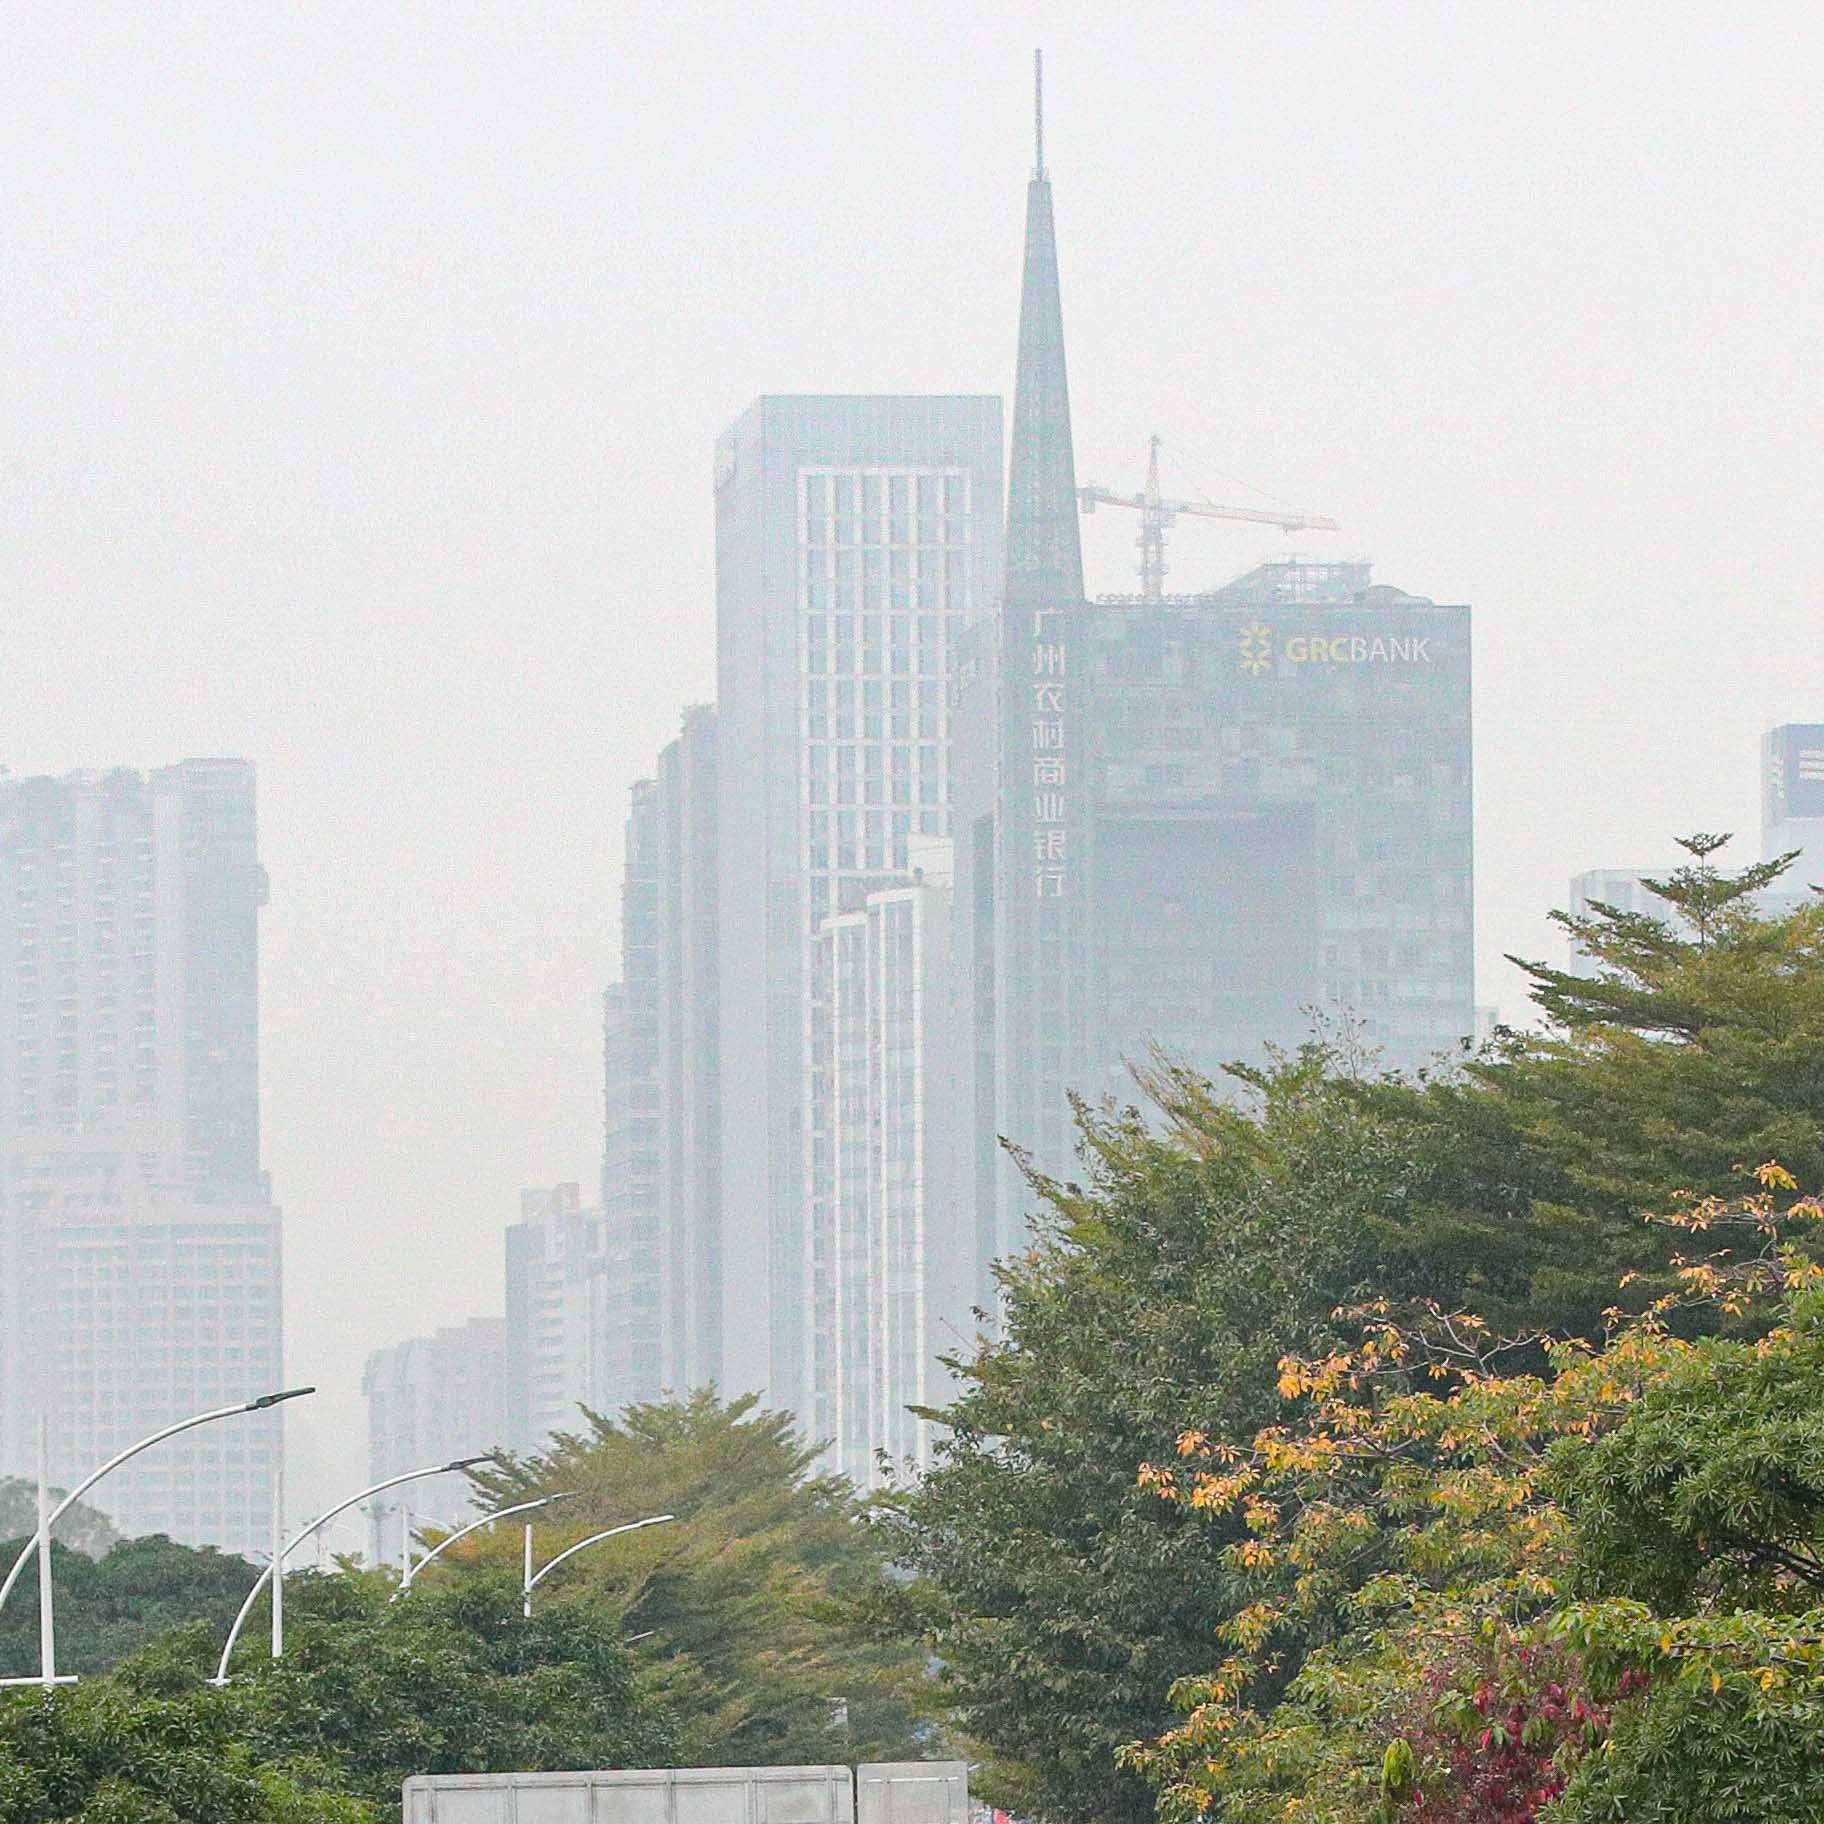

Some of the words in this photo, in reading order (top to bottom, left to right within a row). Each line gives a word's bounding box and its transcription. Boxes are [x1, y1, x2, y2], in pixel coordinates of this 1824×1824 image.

[1285, 637, 1431, 664] GRCBANK
[1032, 606, 1067, 898] 广州农村商业银行
